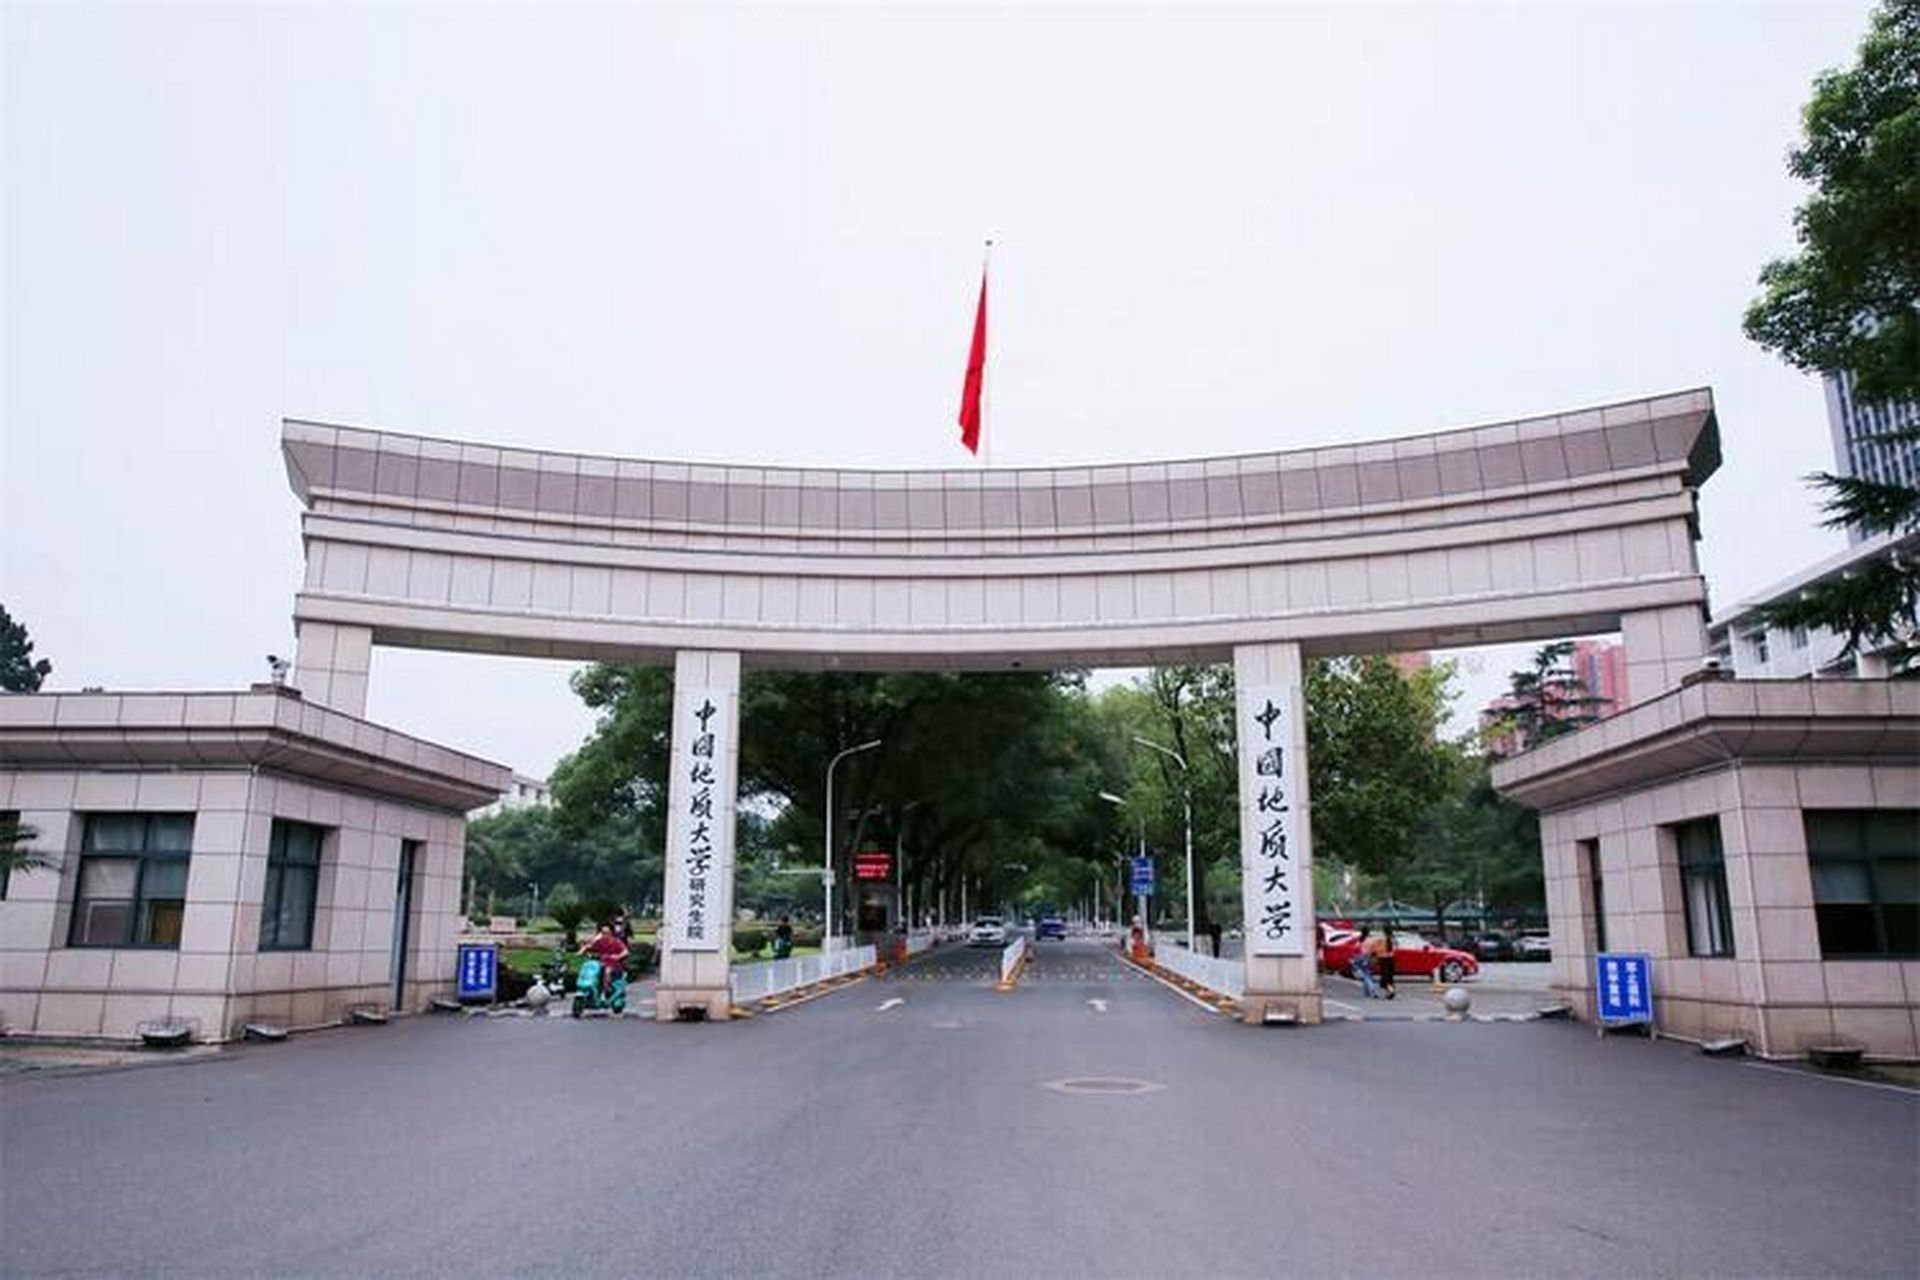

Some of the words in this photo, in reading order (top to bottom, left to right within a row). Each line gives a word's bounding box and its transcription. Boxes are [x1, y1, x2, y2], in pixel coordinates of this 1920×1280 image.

[1255, 699, 1291, 940] 中国地质大学
